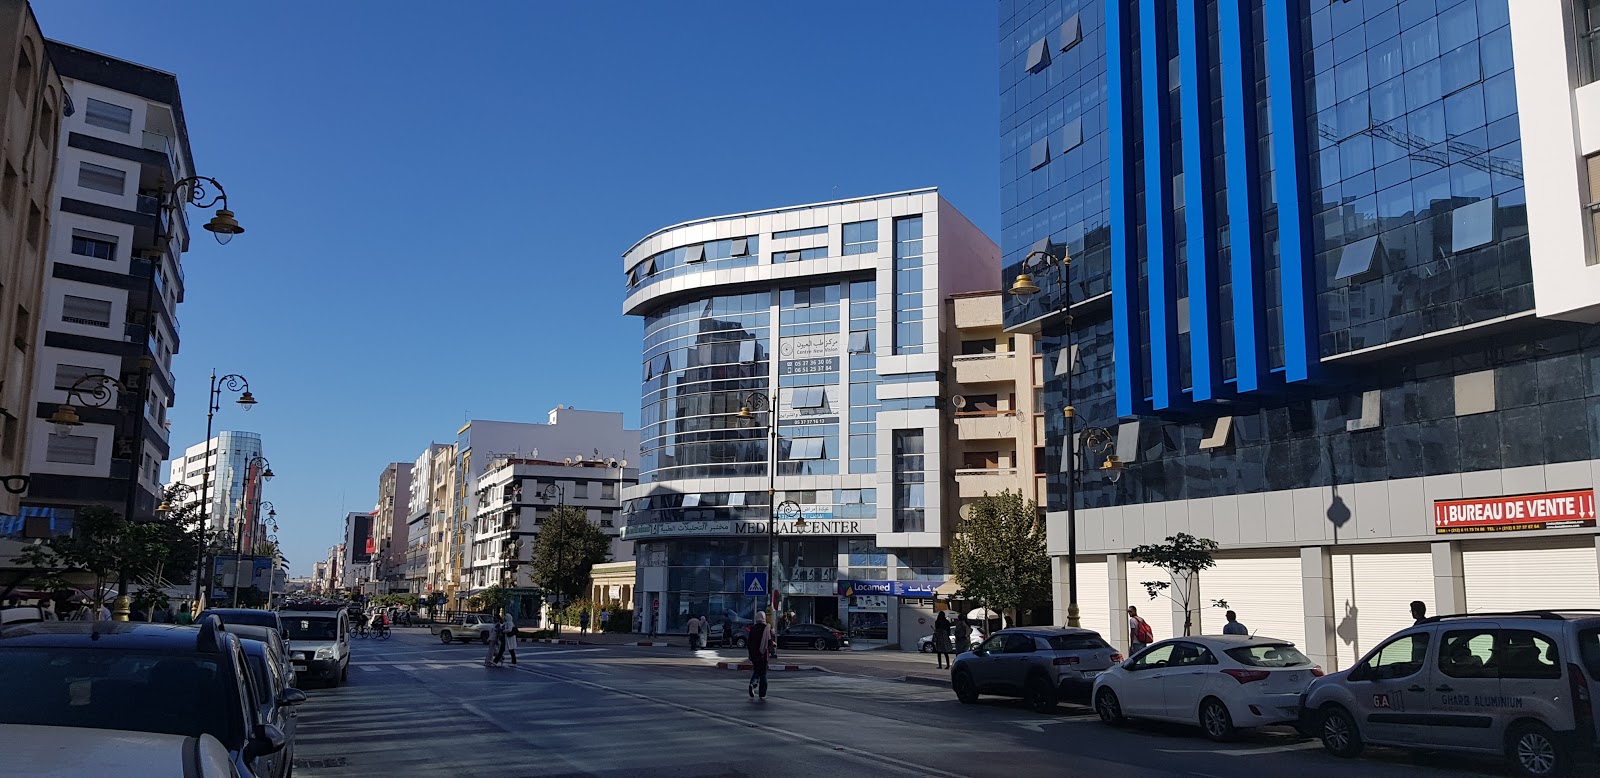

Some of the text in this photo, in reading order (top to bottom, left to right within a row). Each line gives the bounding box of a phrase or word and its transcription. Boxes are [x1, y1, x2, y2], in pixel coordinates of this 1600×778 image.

[797, 338, 838, 350] مركز طب العيون
[1449, 497, 1575, 522] BUREAU DE VENTE
[678, 523, 708, 532] التحليلات
[709, 524, 729, 532] مختبر
[804, 521, 860, 534] CENTER
[854, 582, 890, 591] Locamed
[908, 584, 936, 596] وكامد
[1373, 695, 1389, 707] G.A
[1441, 695, 1523, 708] GHARB ALUMINIUM
